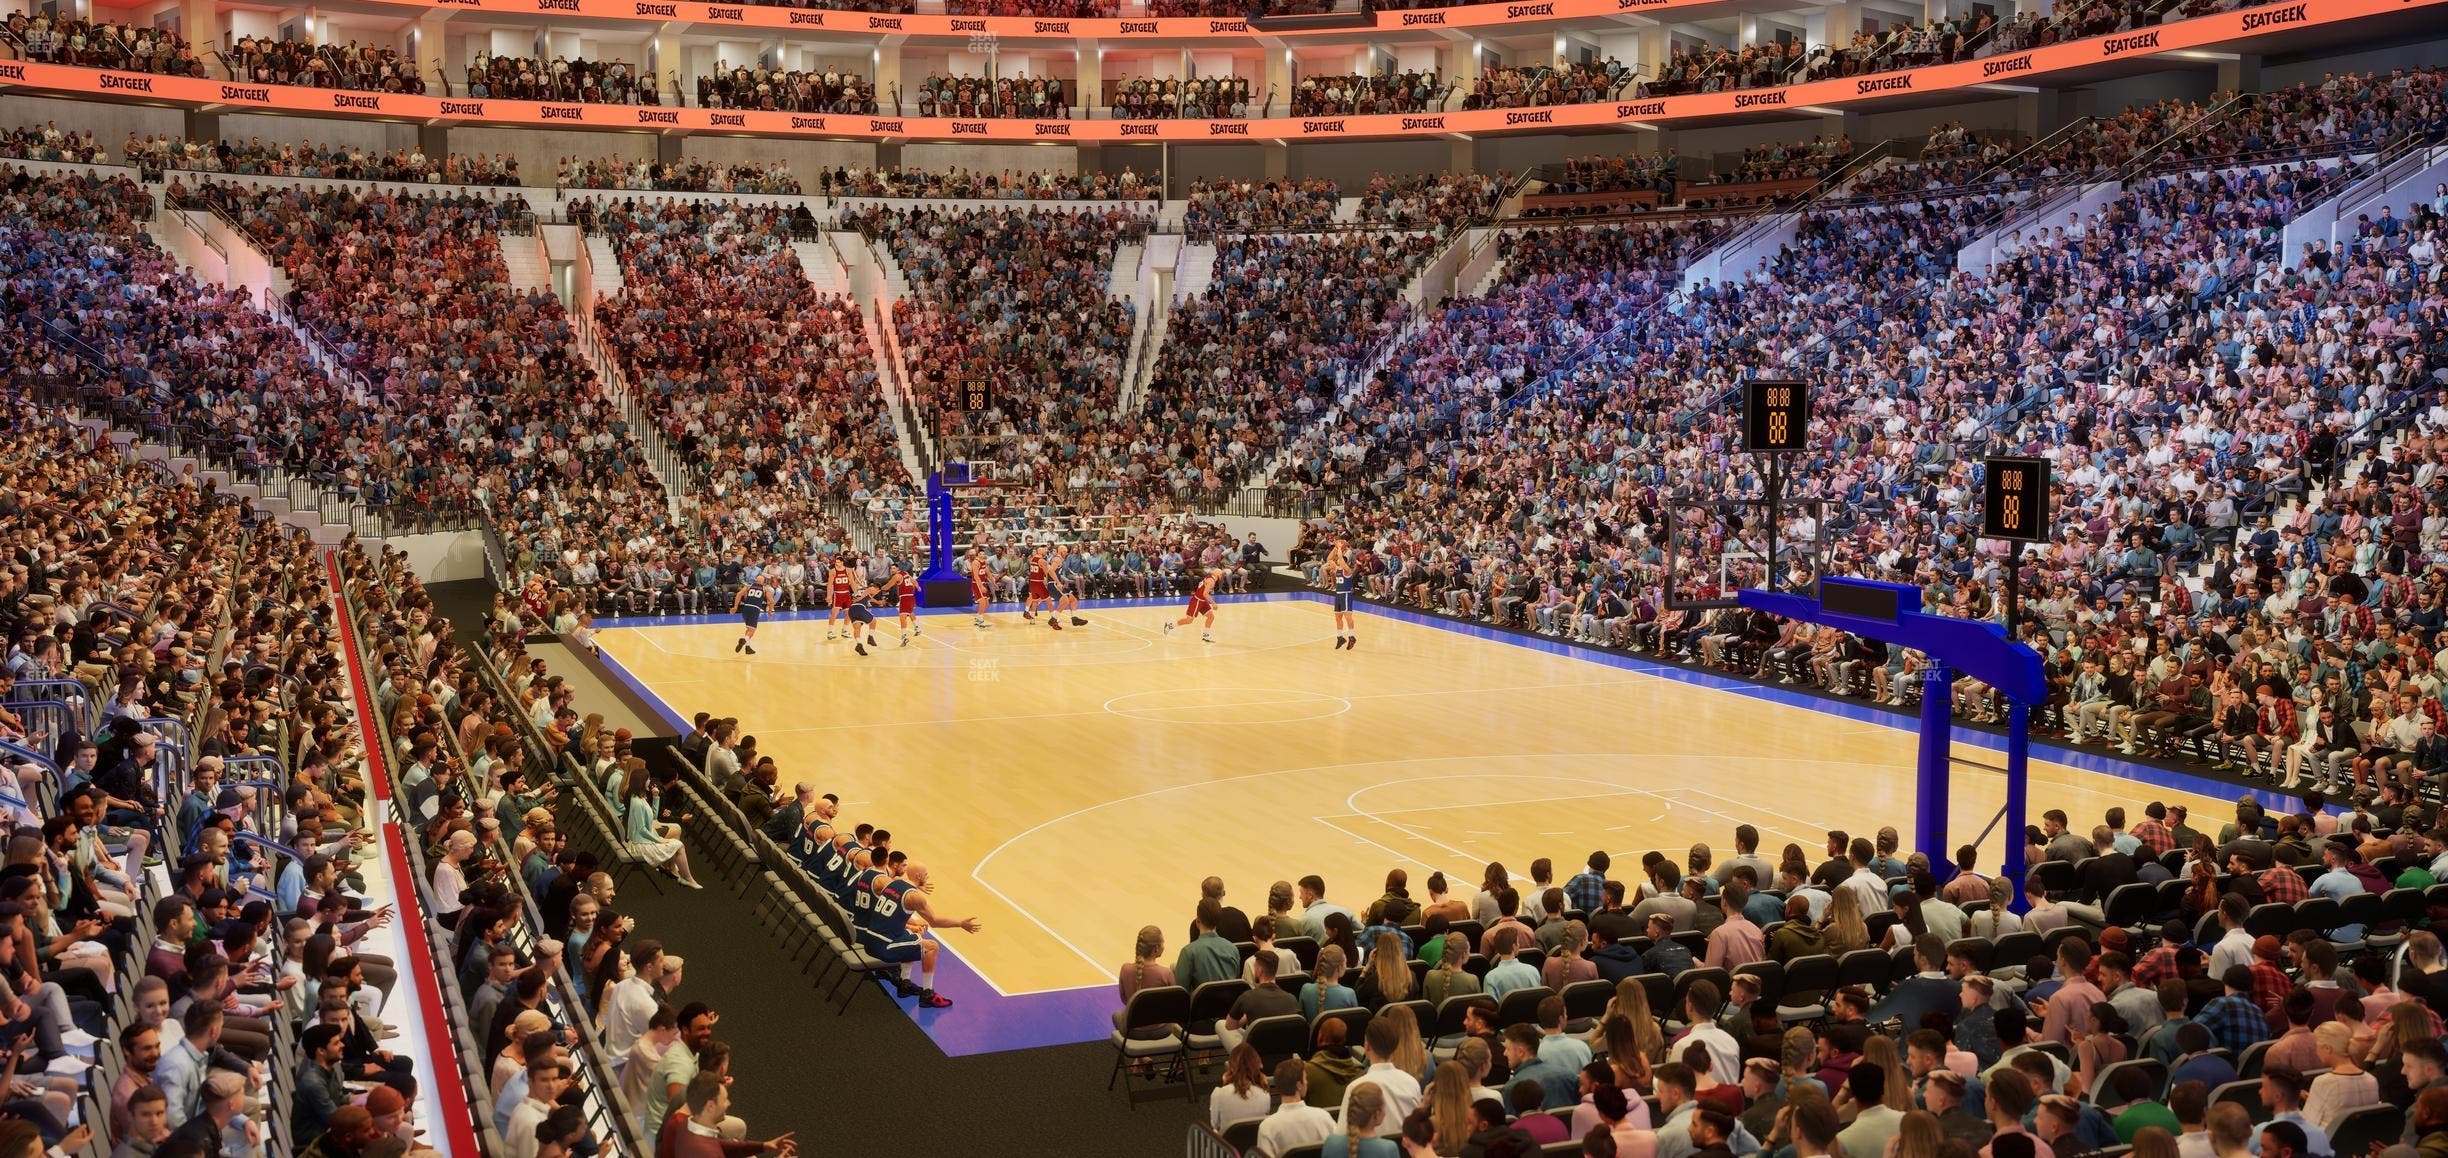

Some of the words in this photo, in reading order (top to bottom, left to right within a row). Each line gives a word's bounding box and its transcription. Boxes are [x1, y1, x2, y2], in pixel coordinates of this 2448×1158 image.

[637, 3, 676, 17] SEATGEEK
[709, 7, 743, 21] SEATGEEK
[1508, 3, 1553, 18] SEATGEEK
[790, 12, 823, 25] SEATGEEK
[869, 17, 902, 30] SEATGEEK
[1403, 12, 1445, 25] SEATGEEK
[2242, 4, 2306, 31] SEATGEEK
[951, 20, 986, 32] SEATGEEK
[1035, 22, 1069, 34] SEATGEEK
[1121, 22, 1158, 33] SEATGEEK
[1210, 21, 1248, 32] SEATGEEK
[2104, 31, 2159, 55] SEATGEEK
[1984, 54, 2032, 77] SEATGEEK
[100, 74, 152, 92] SEATGEEK
[1858, 74, 1912, 94] SEATGEEK
[222, 86, 269, 102] SEATGEEK
[1735, 91, 1786, 108] SEATGEEK
[334, 94, 379, 110] SEATGEEK
[441, 102, 483, 116] SEATGEEK
[541, 106, 582, 120] SEATGEEK
[639, 110, 678, 124] SEATGEEK
[1507, 110, 1552, 124] SEATGEEK
[1618, 102, 1665, 118] SEATGEEK
[711, 114, 745, 126] SEATGEEK
[792, 117, 825, 130] SEATGEEK
[871, 120, 903, 133] SEATGEEK
[1304, 120, 1344, 133] SEATGEEK
[1402, 117, 1444, 130] SEATGEEK
[952, 122, 987, 135] SEATGEEK
[1036, 124, 1070, 135] SEATGEEK
[1121, 124, 1158, 135] SEATGEEK
[1211, 123, 1248, 135] SEATGEEK
[1769, 412, 1787, 444] 88
[2003, 495, 2019, 529] 88
